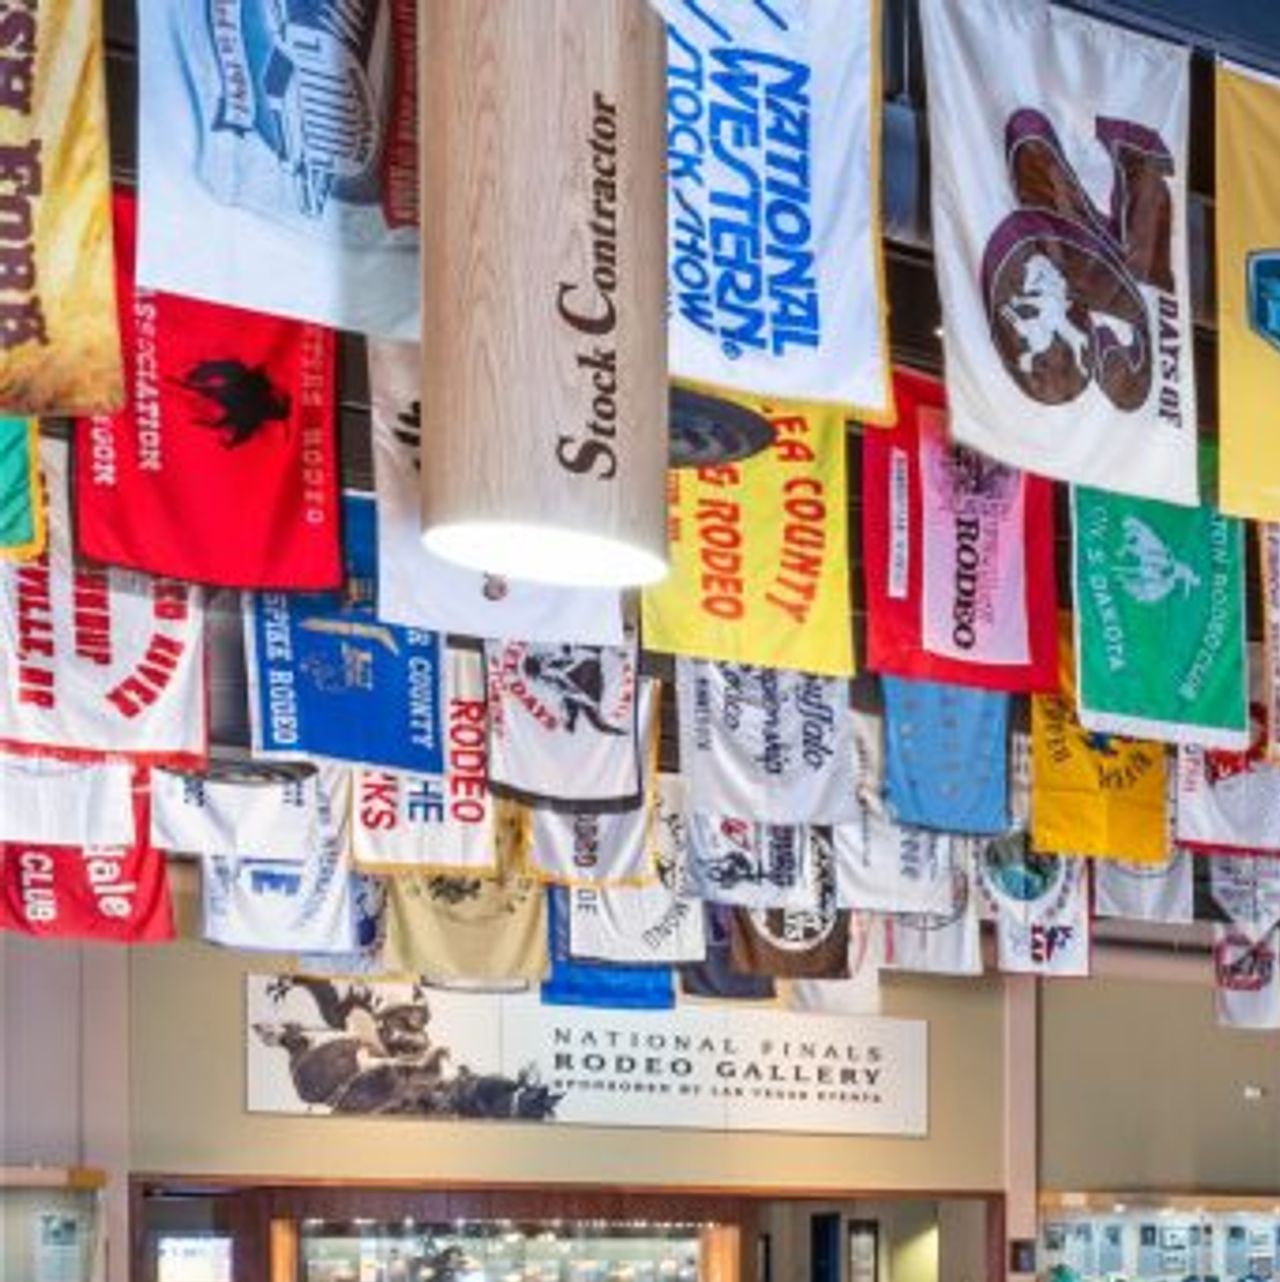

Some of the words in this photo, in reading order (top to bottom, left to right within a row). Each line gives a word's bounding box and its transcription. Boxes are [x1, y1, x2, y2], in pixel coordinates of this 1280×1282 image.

[556, 92, 619, 336] Contractor
[669, 180, 718, 337] SHOW
[708, 44, 768, 354] WESTERN
[750, 46, 820, 357] NATIONAL
[980, 107, 1176, 414] 76
[1157, 296, 1182, 382] DAYS
[556, 347, 618, 482] Stock
[1159, 385, 1183, 429] OF
[697, 502, 745, 620] RODEO
[767, 479, 827, 624] COUNTY
[953, 513, 980, 650] RODEO
[271, 668, 299, 746] RODEO
[405, 655, 434, 750] COUNTY
[448, 699, 487, 824] RODEO
[19, 851, 55, 921] CLUB
[553, 1027, 739, 1056] NATIONAL
[761, 1041, 883, 1062] FINALS
[553, 1052, 694, 1077] RODEO
[716, 1060, 882, 1087] GALLERY
[553, 1078, 672, 1095] SPONSORED
[679, 1083, 700, 1096] BY
[711, 1086, 746, 1099] LAS
[753, 1088, 809, 1102] VEGAS
[816, 1091, 882, 1104] EVENTS
